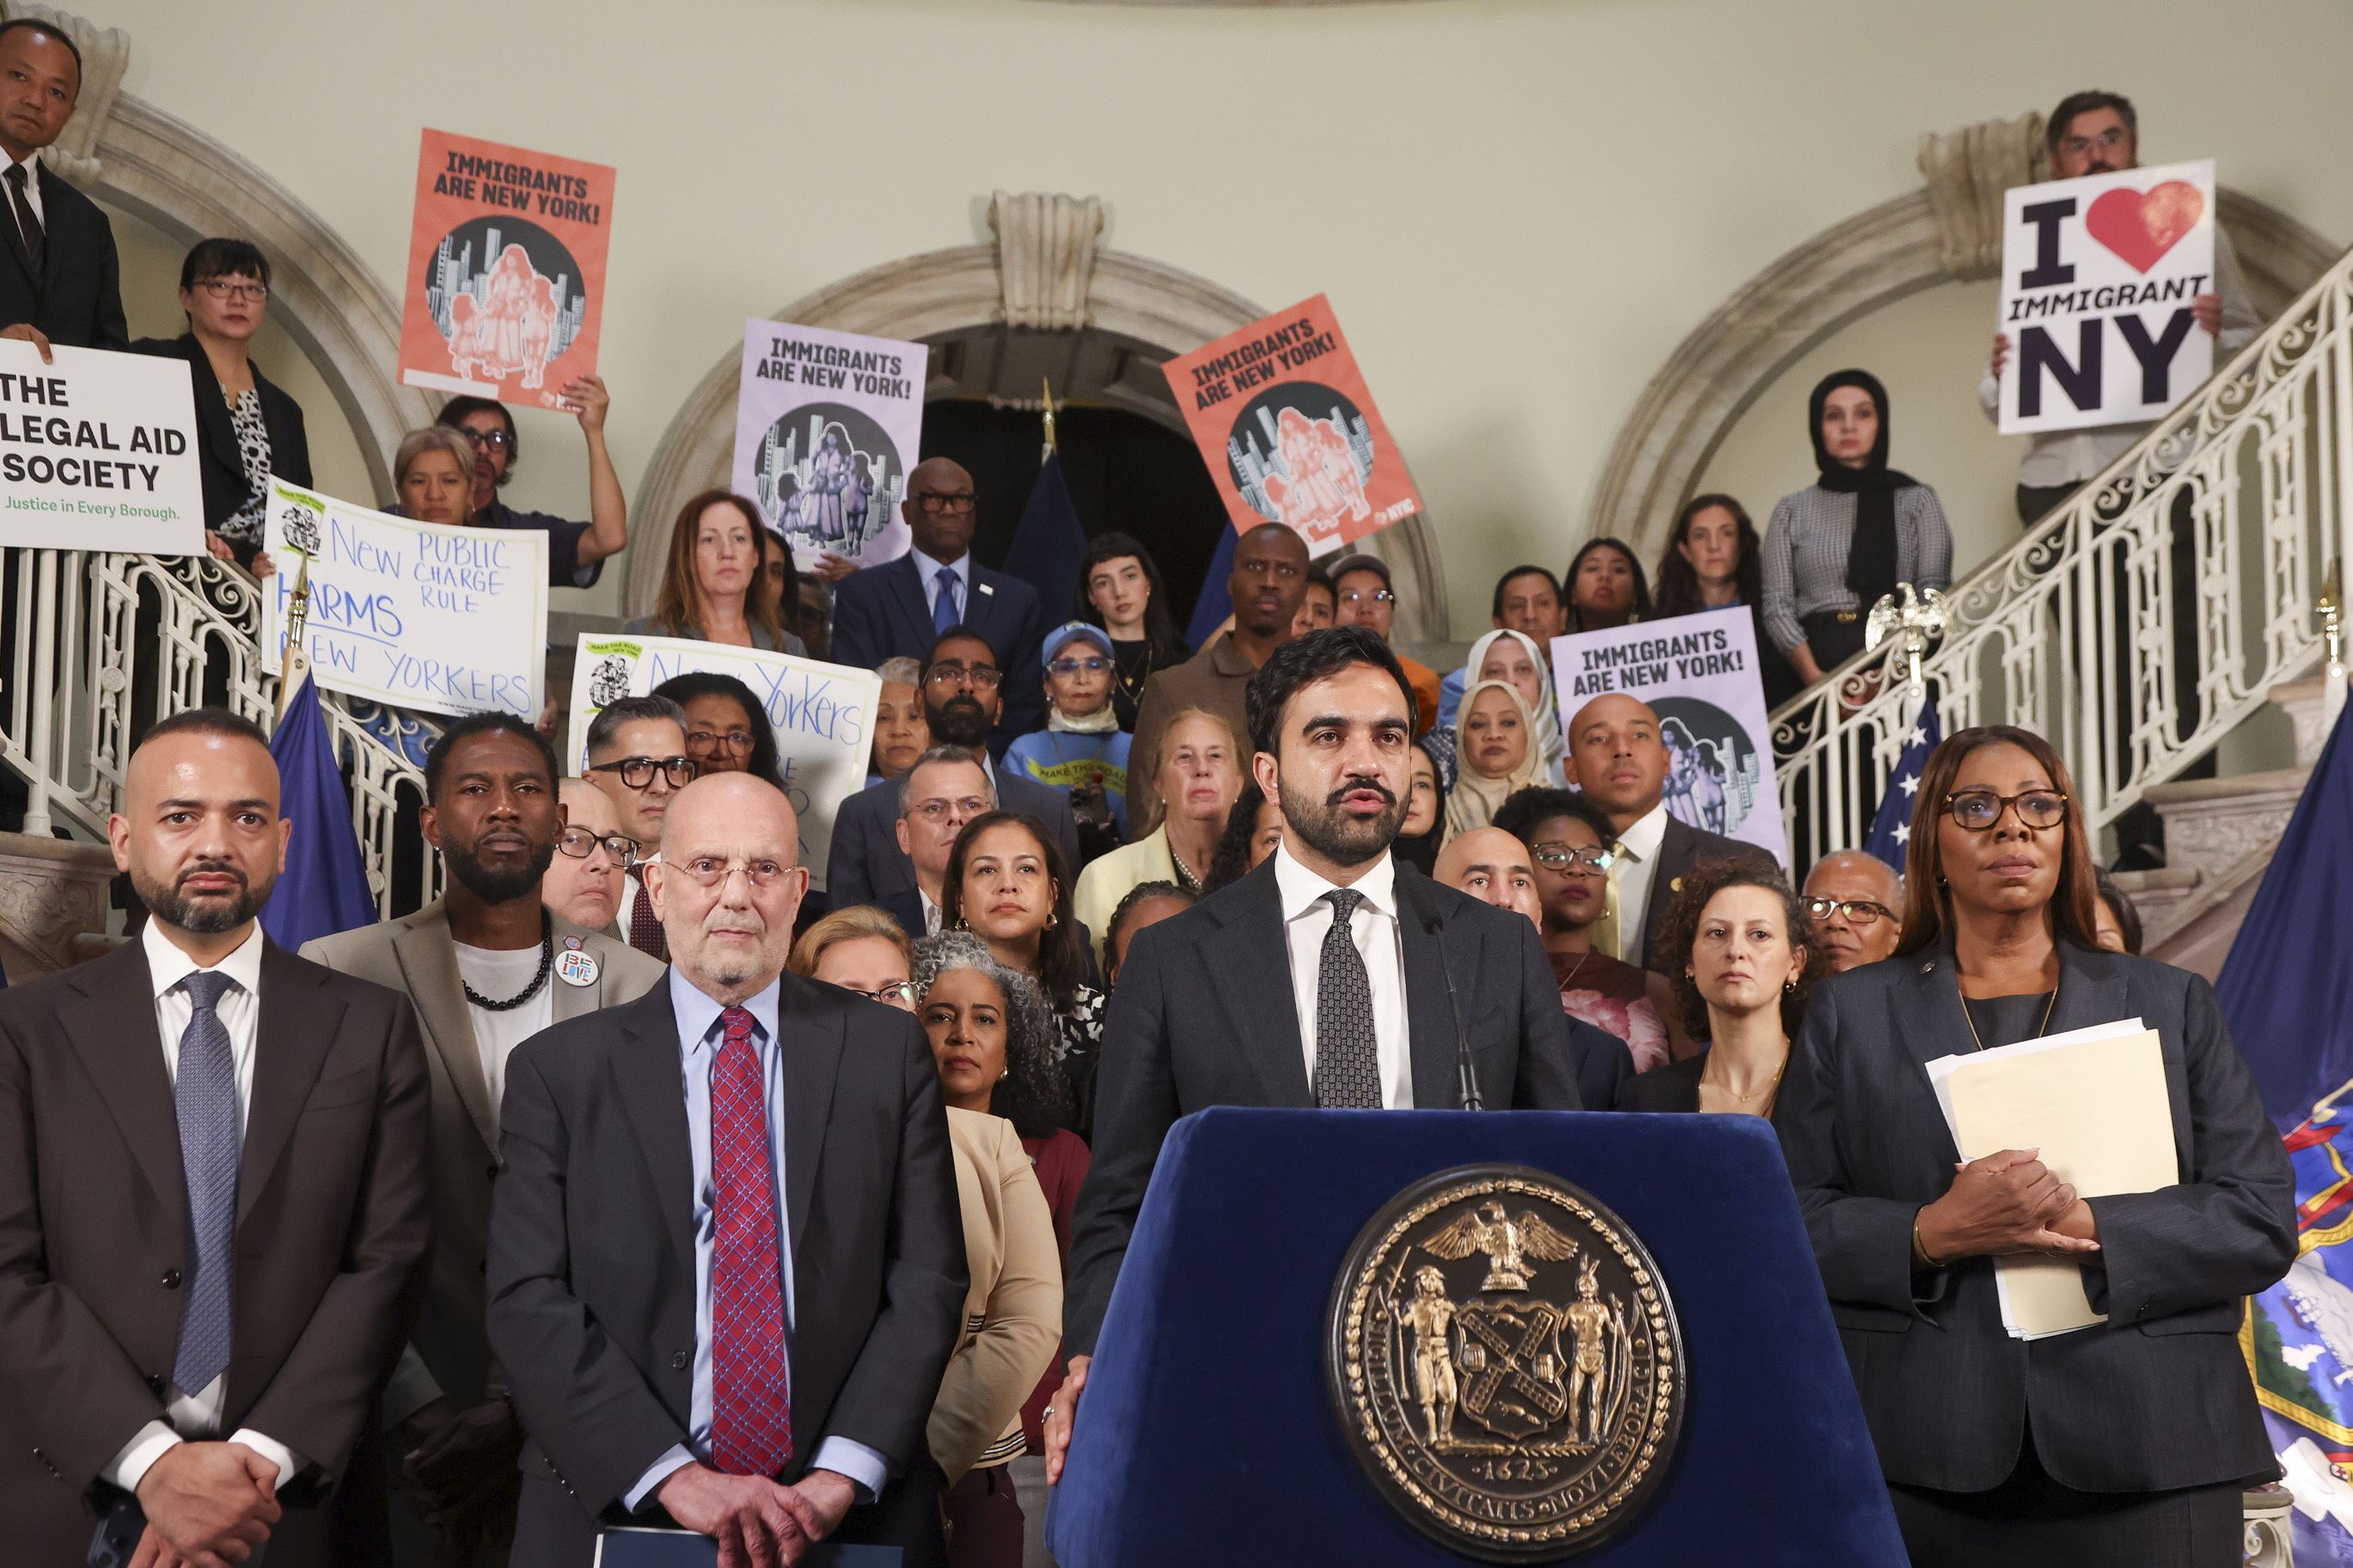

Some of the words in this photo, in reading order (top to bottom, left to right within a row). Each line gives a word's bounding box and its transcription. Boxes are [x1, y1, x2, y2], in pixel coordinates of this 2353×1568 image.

[446, 150, 588, 198] IMMIGRANTS
[434, 174, 475, 200] ARE
[482, 184, 530, 210] NEW
[537, 193, 600, 225] YORK!
[2021, 197, 2076, 290] I
[2008, 275, 2208, 321] IMMIGRANT
[771, 337, 901, 375] IMMIGRANTS
[1191, 317, 1315, 387] IMMIGRANTS
[1194, 380, 1232, 412] ARE
[1232, 358, 1277, 393] NEW
[1277, 330, 1337, 370] YORK!
[2018, 308, 2197, 418] NY
[0, 373, 69, 407] THE
[756, 357, 795, 381] ARE
[801, 365, 846, 389] NEW
[853, 374, 912, 400] YORK!
[0, 412, 120, 451] LEGAL
[130, 425, 186, 455] AID
[3, 453, 160, 491] SOCIETY
[5, 496, 58, 512] Justice
[61, 499, 74, 513] in
[78, 501, 116, 518] Every
[120, 503, 180, 522] Borough.
[417, 532, 510, 569] PUBLIC
[413, 561, 504, 595] CHARGE
[421, 584, 479, 613] RULE
[1582, 629, 1727, 671] IMMIGRANTS
[384, 650, 532, 713] YORKERS
[1574, 670, 1615, 697] ARE
[1621, 662, 1668, 689] NEW
[1676, 650, 1744, 680] YORK!
[1040, 767, 1071, 778] MAKE
[1412, 1457, 1535, 1520] CIVITATIS
[1547, 1463, 1611, 1515] NOVI
[1609, 1354, 1651, 1467] EBORACI
[1482, 1459, 1550, 1481] 1625
